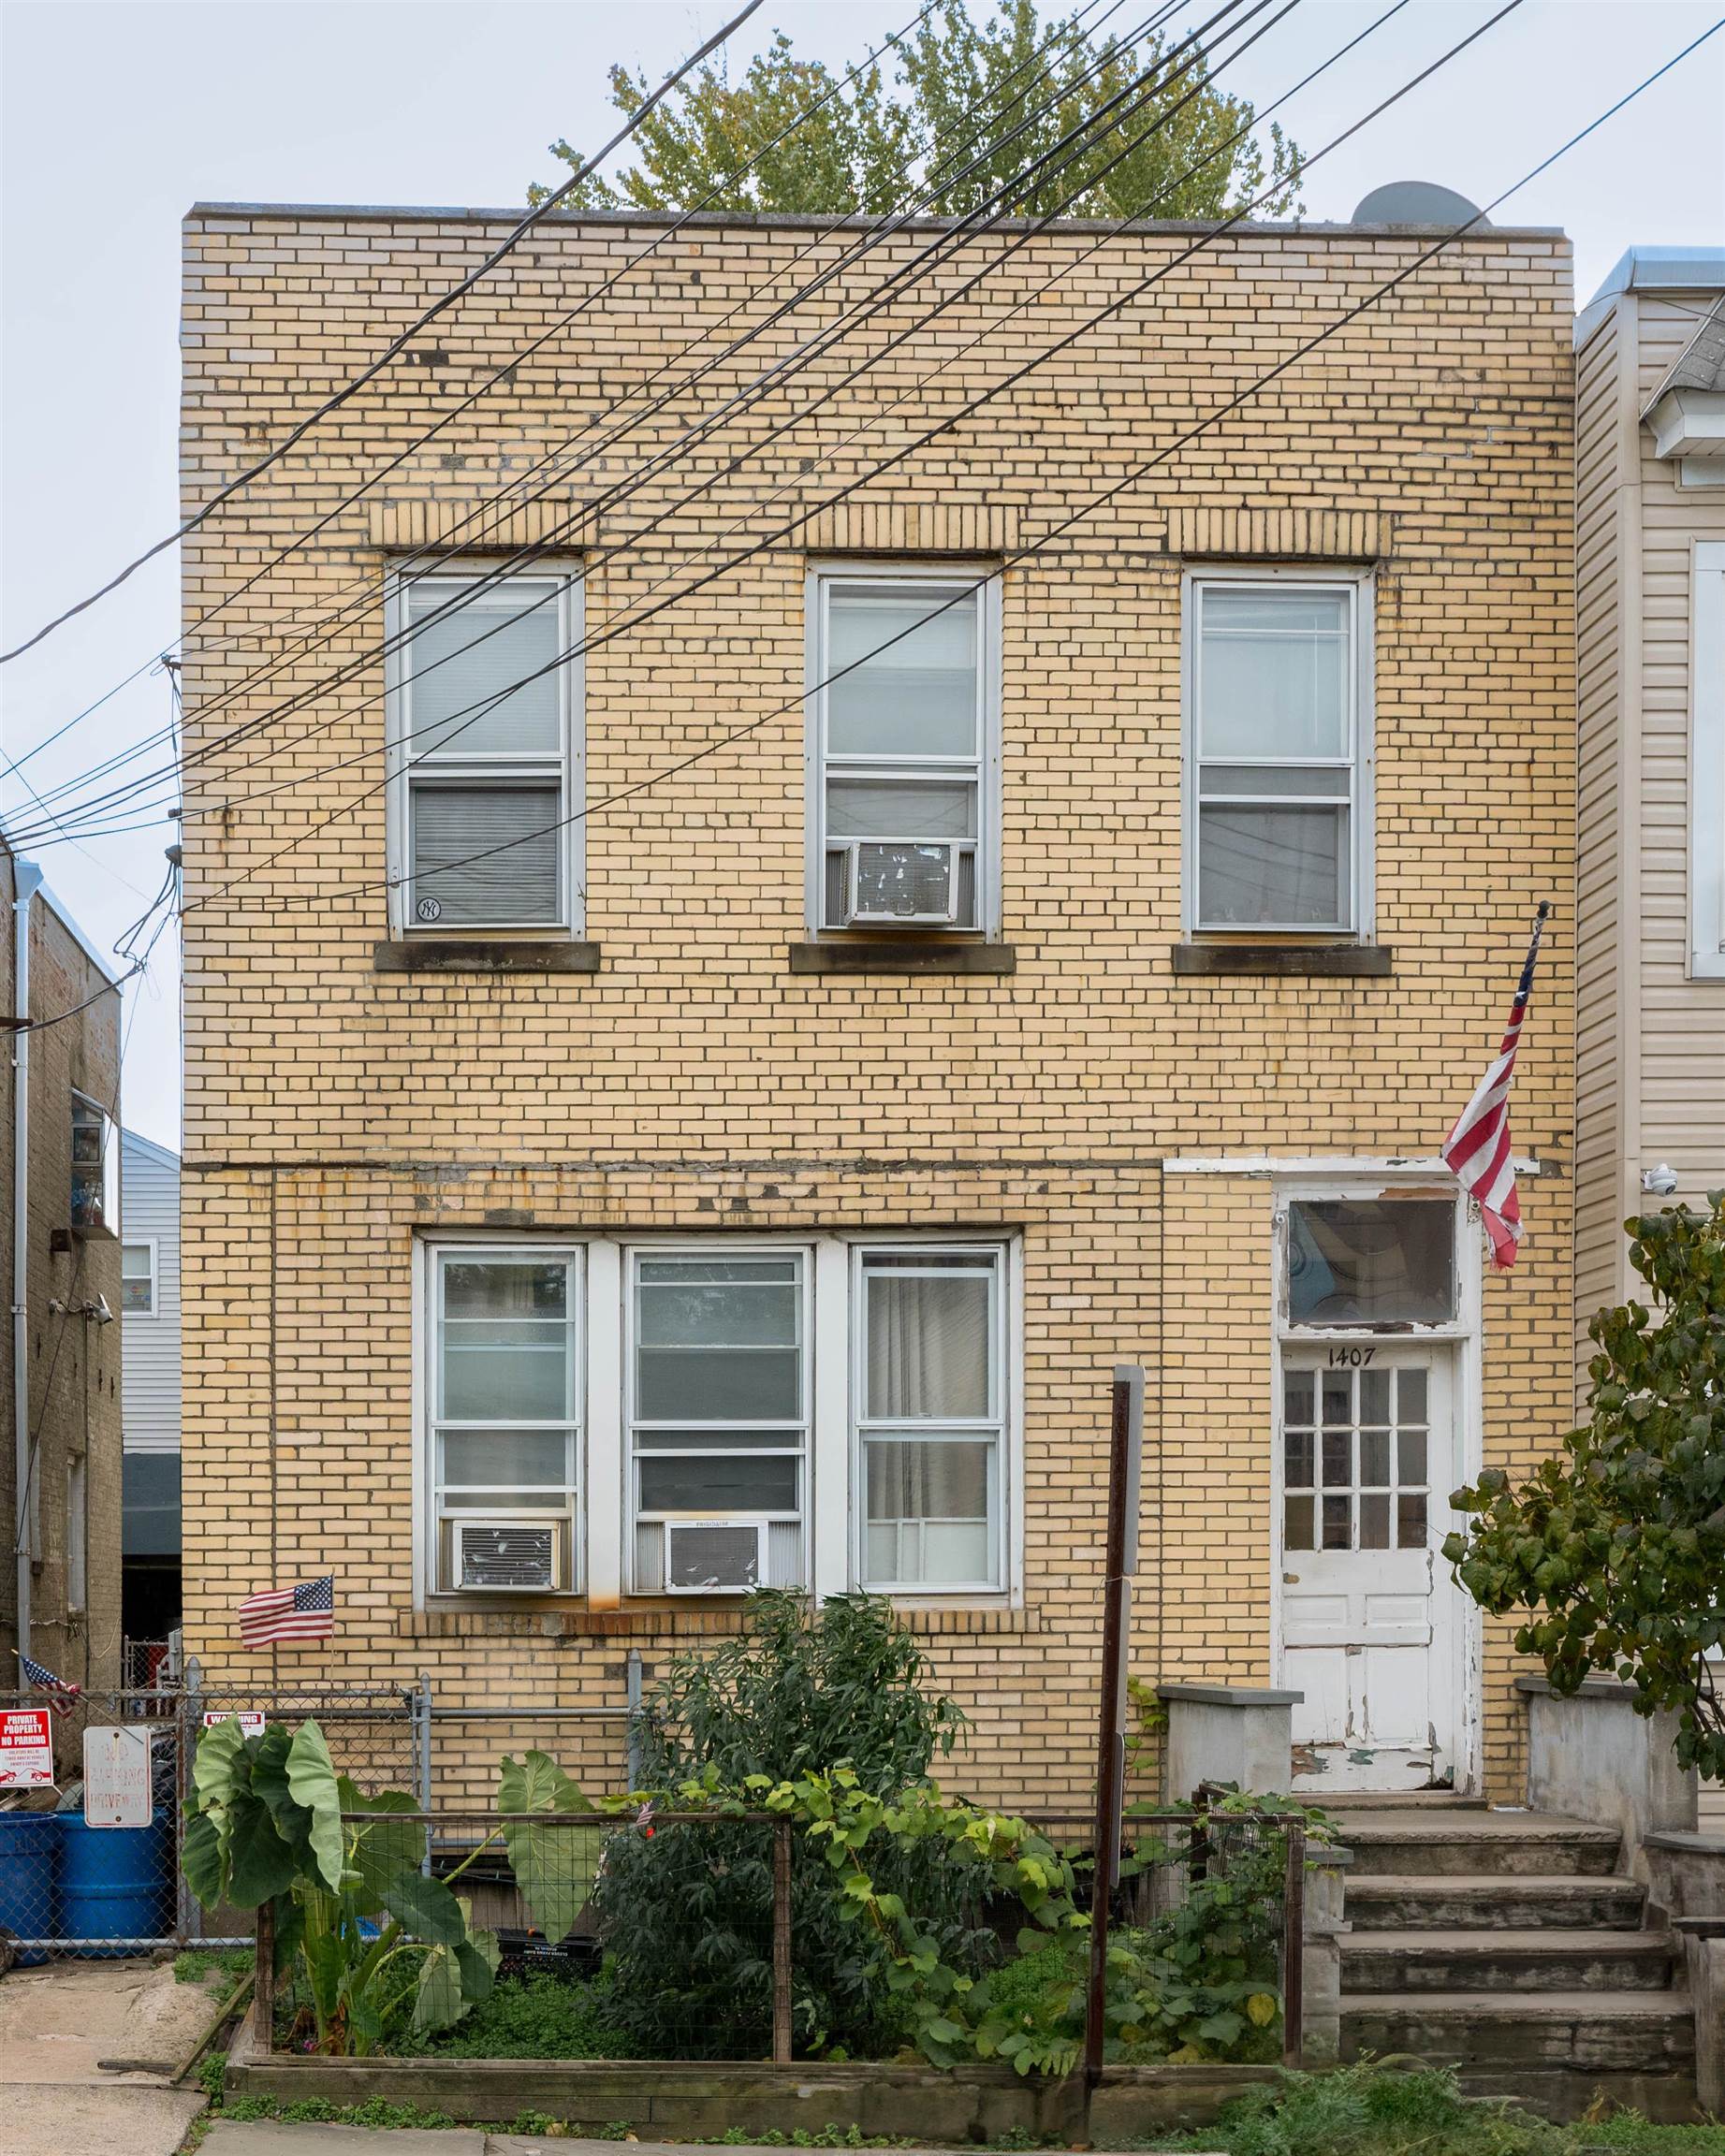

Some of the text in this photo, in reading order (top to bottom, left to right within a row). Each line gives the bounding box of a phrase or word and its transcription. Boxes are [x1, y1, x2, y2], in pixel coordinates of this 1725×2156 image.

[1329, 1348, 1377, 1367] 1407
[7, 1714, 38, 1725] PRIVATE
[210, 1715, 258, 1724] WAING
[4, 1724, 43, 1734] PROPERTY
[1, 1735, 46, 1746] NO PARKING
